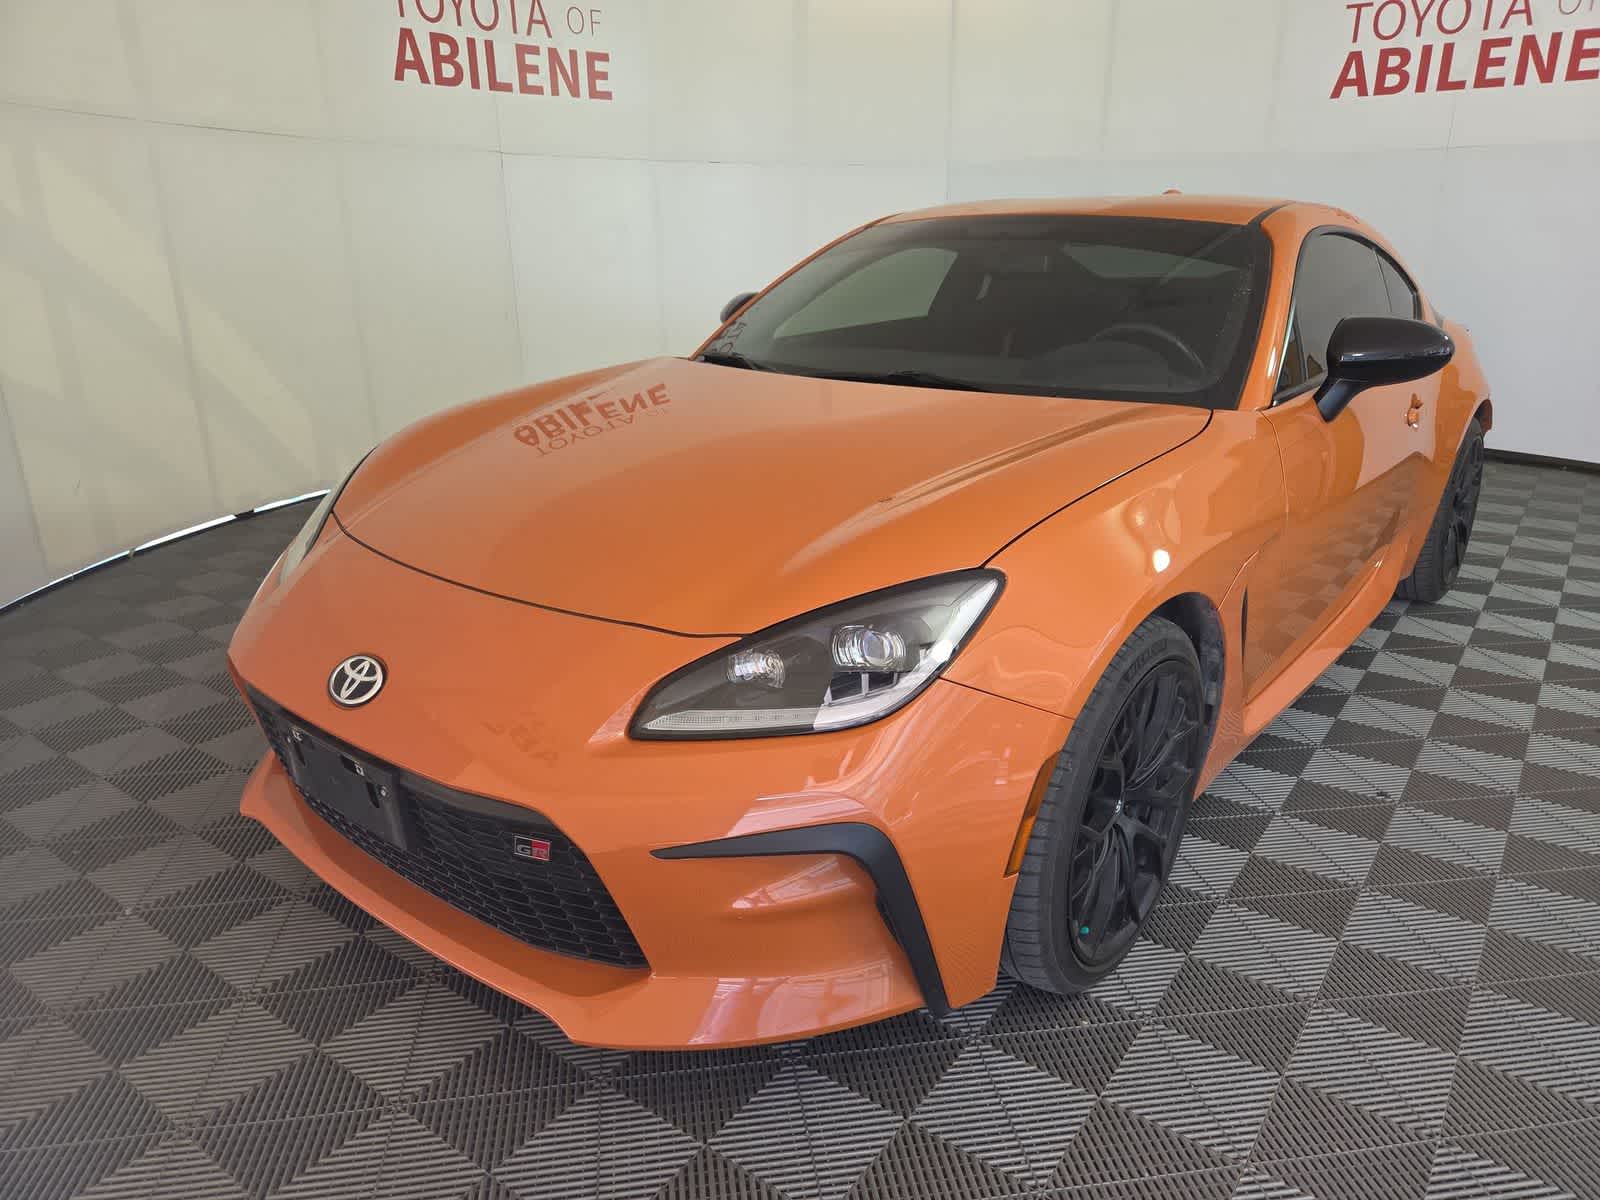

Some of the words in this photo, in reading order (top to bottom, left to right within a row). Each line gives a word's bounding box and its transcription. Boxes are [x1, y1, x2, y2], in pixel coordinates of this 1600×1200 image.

[567, 7, 601, 36] OF
[394, 27, 612, 101] ABILENE
[1329, 28, 1600, 99] ABILENE
[517, 844, 548, 860] GR
